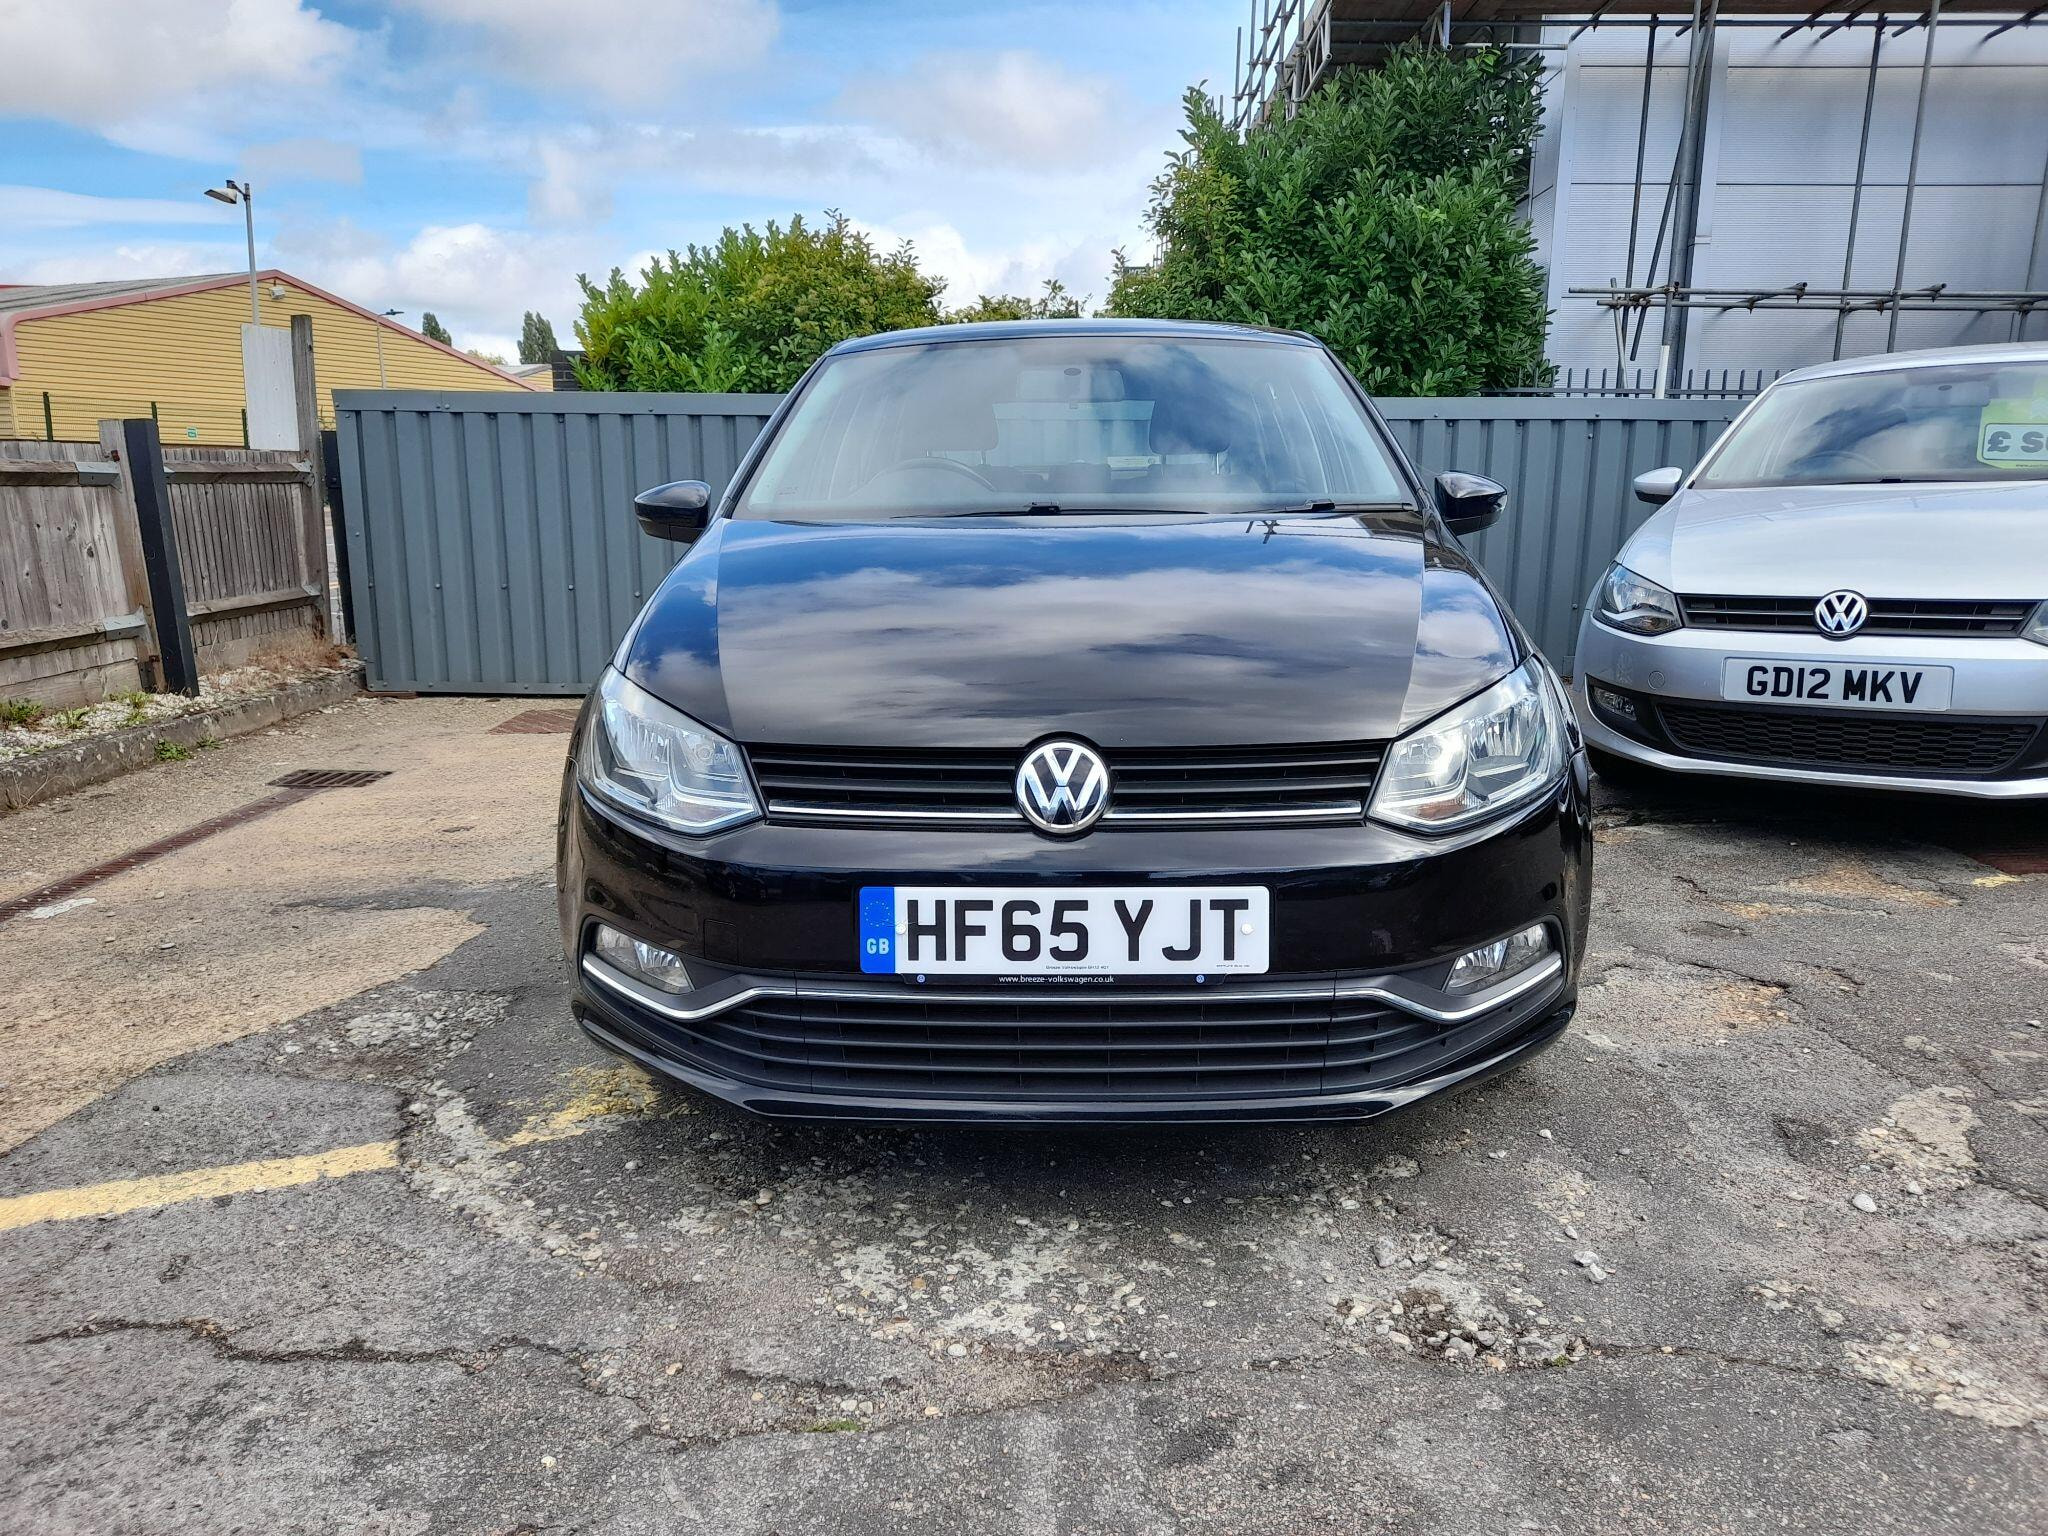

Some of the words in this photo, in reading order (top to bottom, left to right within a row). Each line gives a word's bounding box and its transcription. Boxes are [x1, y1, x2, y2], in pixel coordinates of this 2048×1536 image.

[1987, 431, 2012, 453] £
[2020, 431, 2048, 454] S
[1746, 665, 1831, 700] GD12
[1842, 669, 1923, 704] MKV
[907, 899, 1089, 962] HF65
[1114, 899, 1249, 961] YJT
[866, 937, 889, 955] GB
[998, 975, 1115, 985] www.breeze-volkswagen.co.uk
